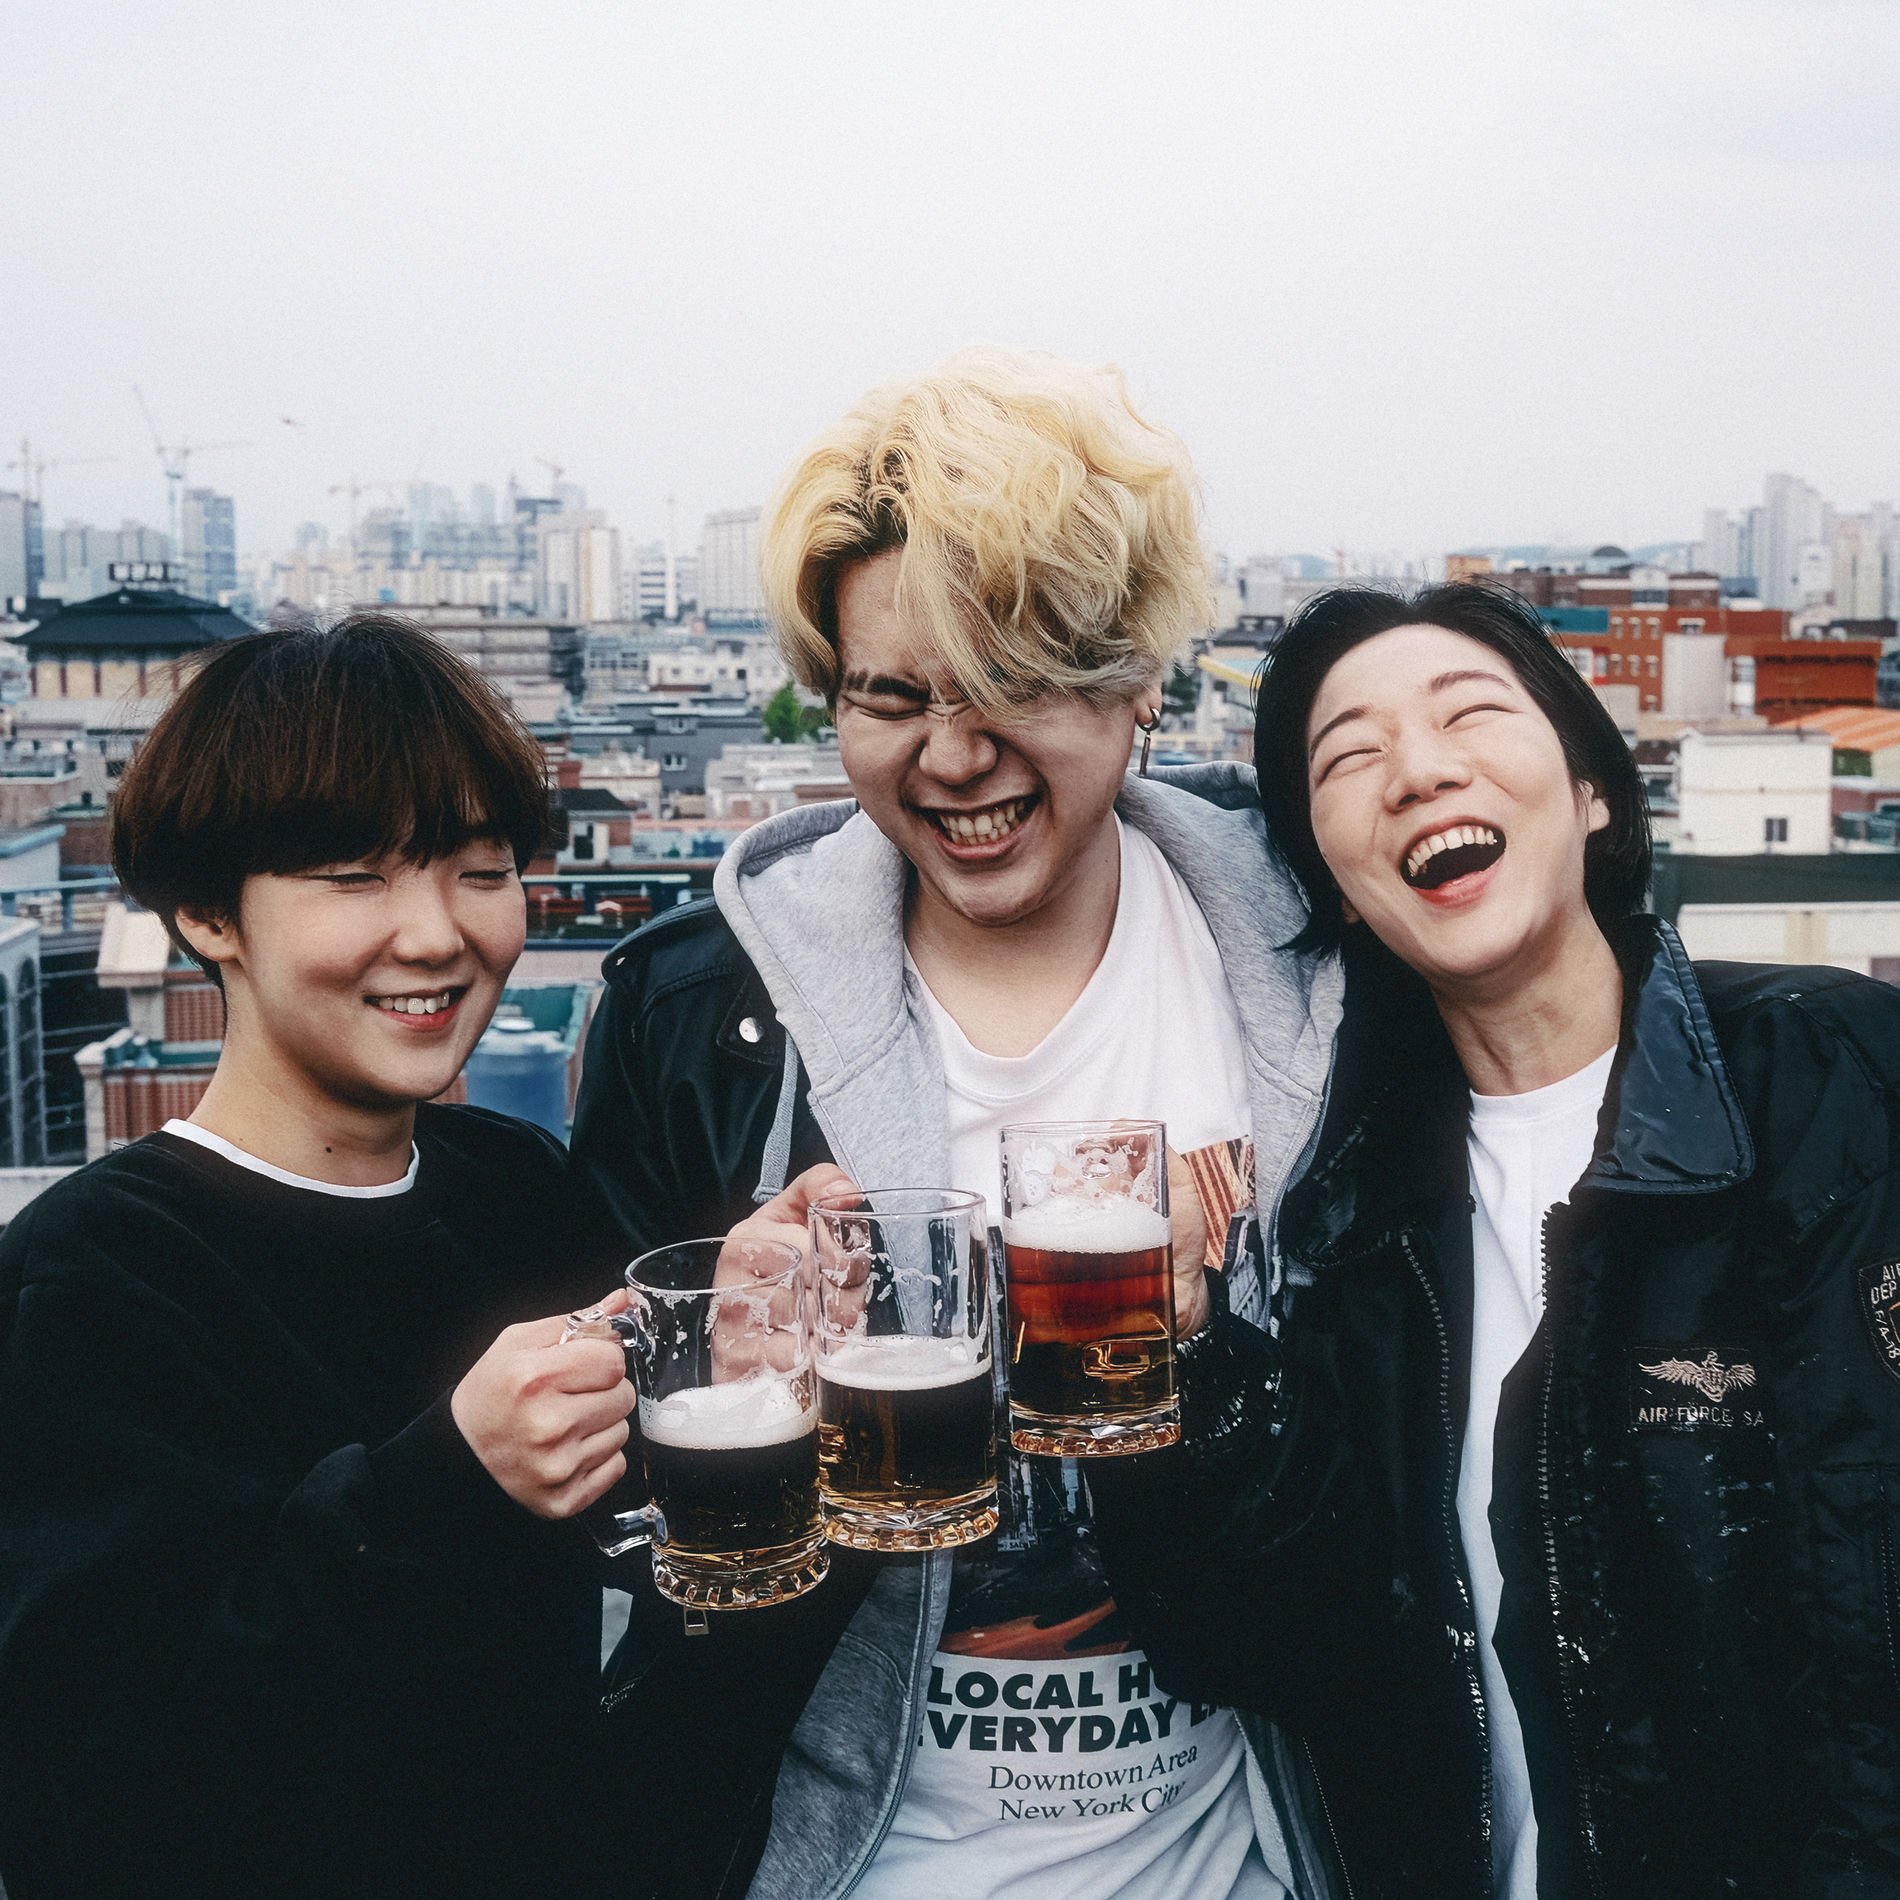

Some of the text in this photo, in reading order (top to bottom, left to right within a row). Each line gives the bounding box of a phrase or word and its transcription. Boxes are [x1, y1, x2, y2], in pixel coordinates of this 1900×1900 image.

[1638, 1407, 1668, 1423] AIR
[1677, 1406, 1733, 1423] FORCE
[927, 1661, 1151, 1710] LOCAL H
[918, 1697, 1178, 1754] VERYDAY
[988, 1745, 1198, 1791] Downtown Area
[999, 1798, 1065, 1821] New
[1074, 1793, 1136, 1818] York
